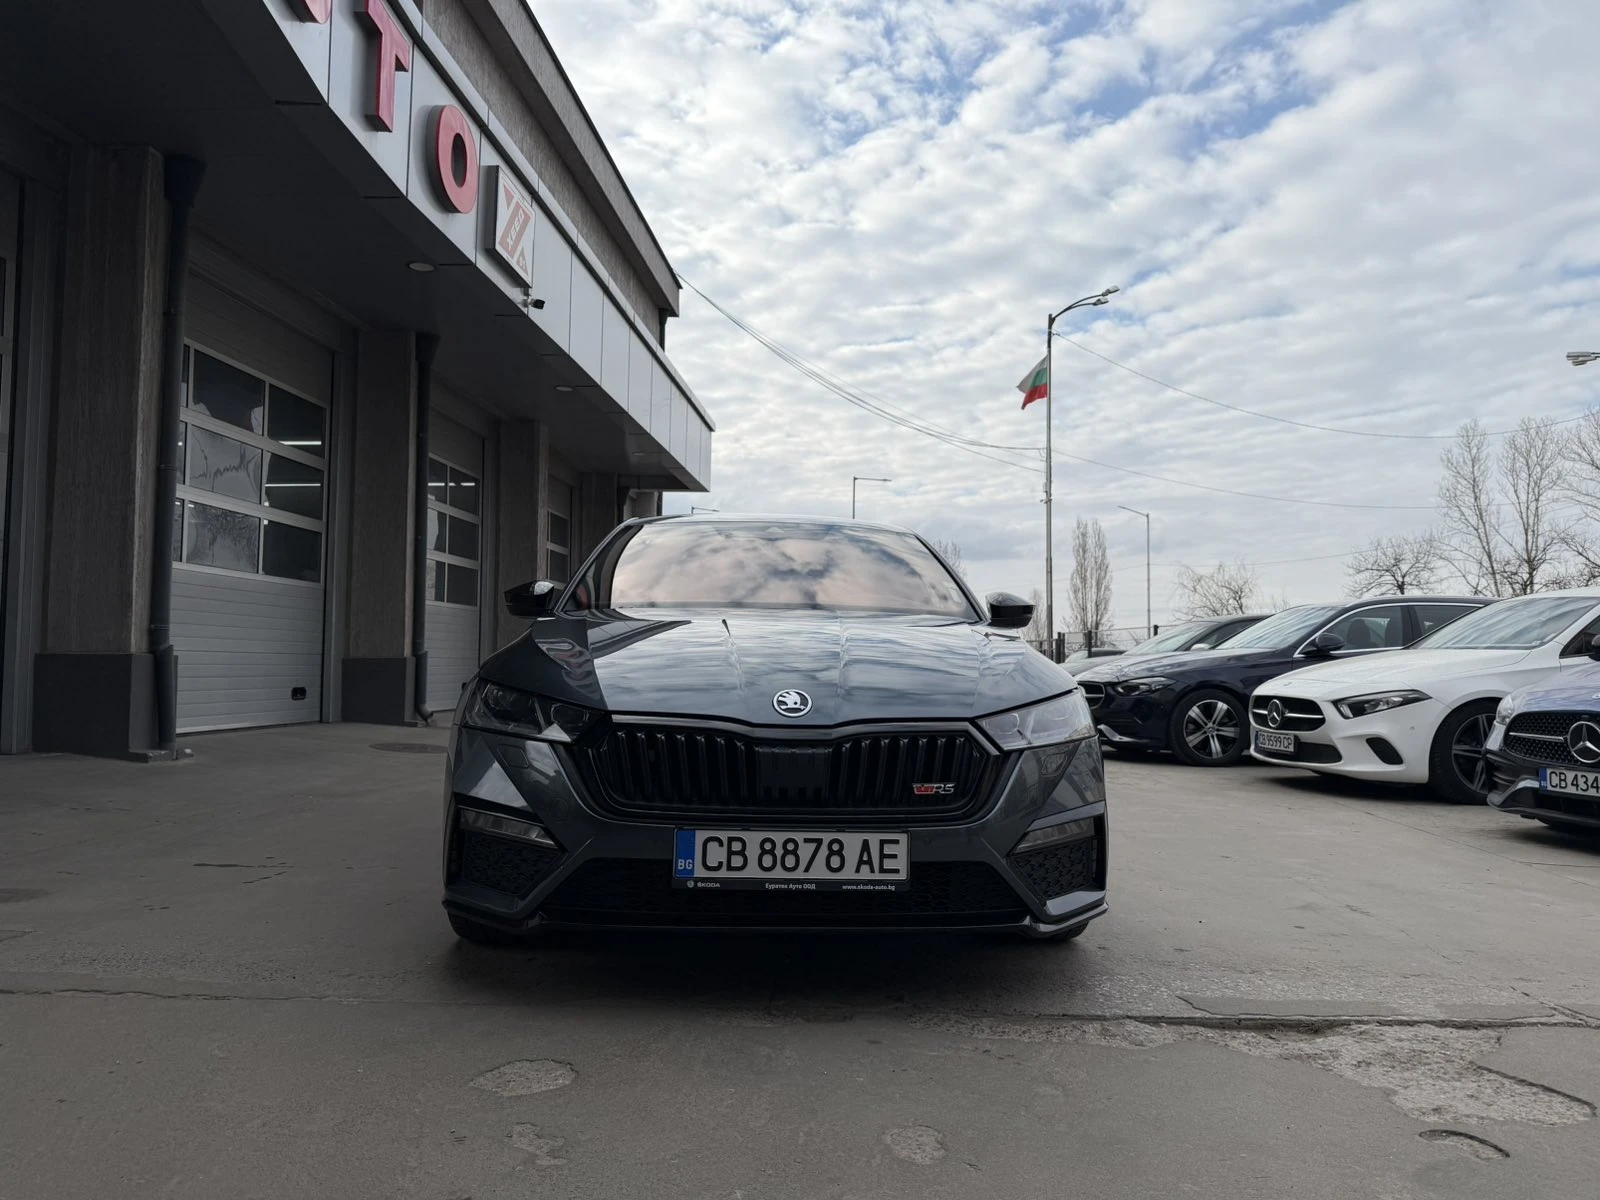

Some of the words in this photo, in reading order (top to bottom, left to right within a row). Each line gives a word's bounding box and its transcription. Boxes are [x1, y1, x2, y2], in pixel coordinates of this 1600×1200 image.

[290, 0, 477, 213] TO
[1549, 771, 1568, 789] CB
[1571, 773, 1600, 793] 434
[678, 859, 693, 870] BG
[701, 836, 749, 872] CB
[757, 836, 846, 874] 8878
[855, 838, 901, 874] AE
